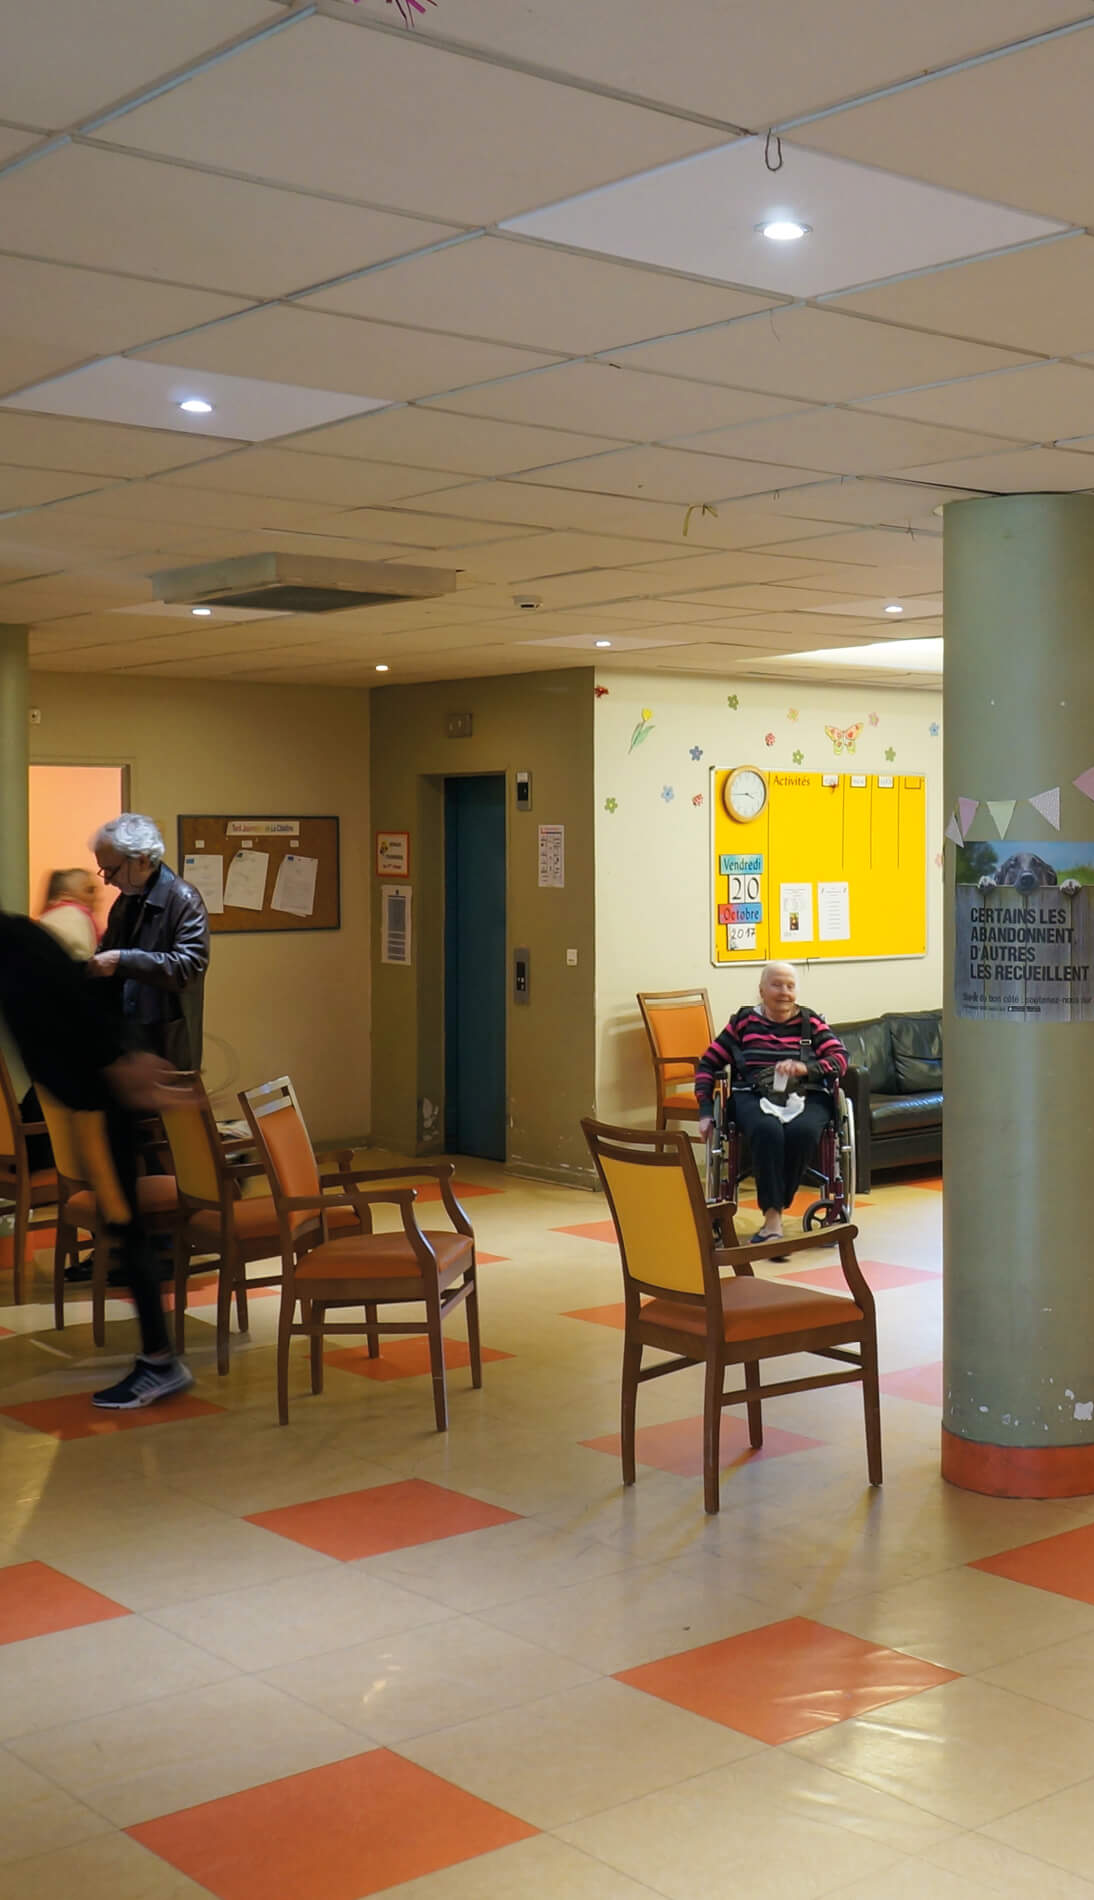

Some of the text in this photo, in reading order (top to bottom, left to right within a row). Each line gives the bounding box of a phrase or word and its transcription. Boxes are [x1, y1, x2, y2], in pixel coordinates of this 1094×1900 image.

[773, 775, 811, 787] Activités
[723, 857, 761, 872] Vendredi
[731, 877, 760, 900] 20
[723, 906, 760, 921] Octobre
[970, 907, 1067, 925] CERTAINS LES
[970, 945, 1036, 962] D'AUTRES
[970, 963, 1090, 982] LES RECUEILLENT
